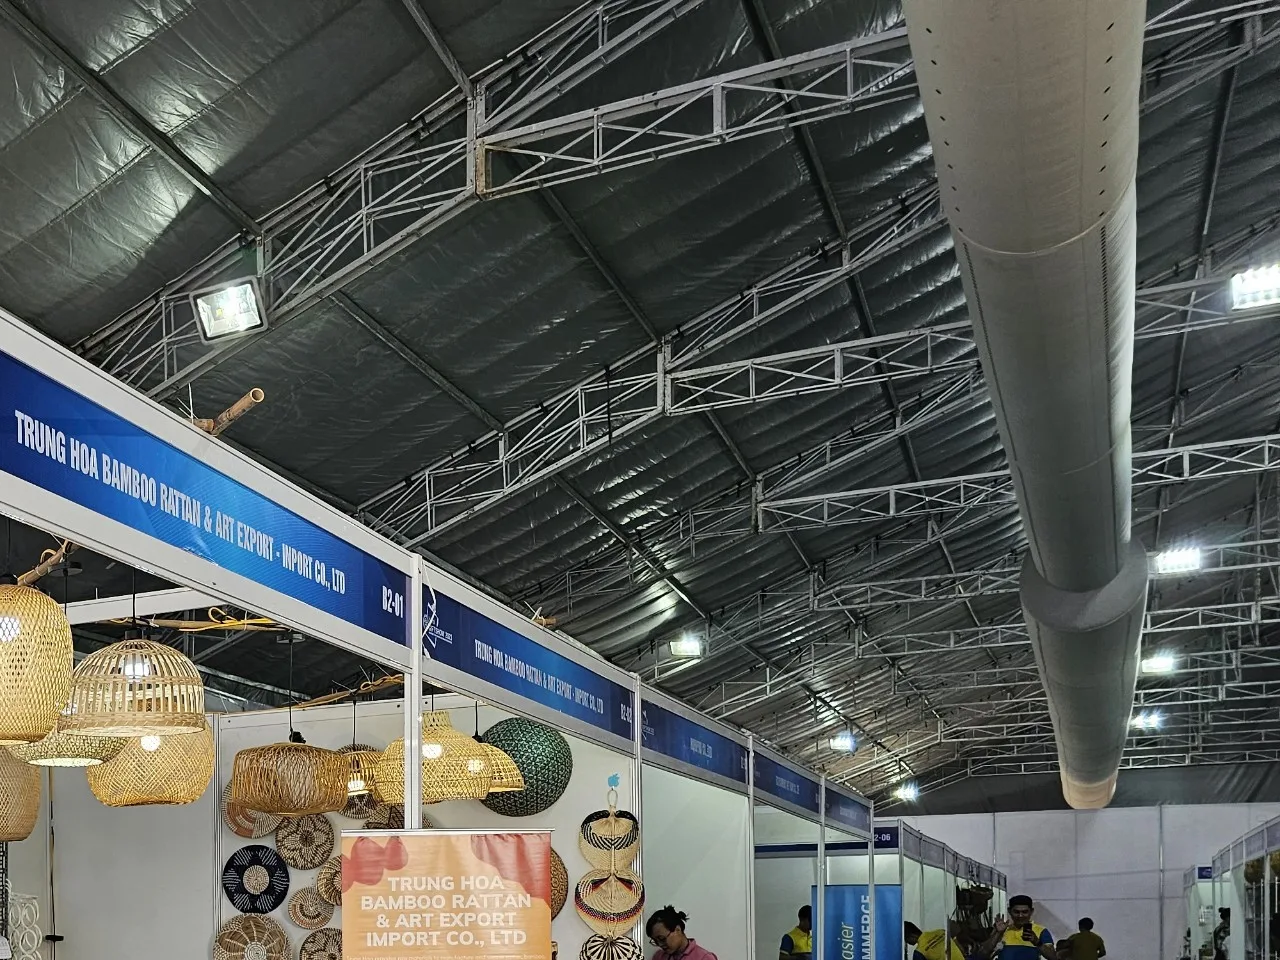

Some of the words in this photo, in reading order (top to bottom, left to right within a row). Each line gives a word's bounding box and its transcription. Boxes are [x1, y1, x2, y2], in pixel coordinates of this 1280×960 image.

[14, 409, 66, 465] TRUNG
[70, 437, 99, 480] HOA
[102, 453, 157, 507] BAMBOO
[160, 482, 201, 528] RATTAN
[203, 505, 213, 534] &
[215, 511, 235, 544] ART
[237, 520, 274, 562] EXPORT
[282, 543, 313, 580] INPORT
[314, 559, 331, 591] CO.,
[331, 567, 346, 595] LTD
[382, 585, 404, 619] B2-01
[474, 638, 492, 664] TRUNG
[493, 648, 505, 670] HOA
[505, 653, 526, 680] BAMBOO
[547, 674, 556, 694] ART
[556, 678, 572, 701] EXPORT
[874, 833, 891, 842] 2-06
[387, 877, 455, 892] TRUNG
[461, 875, 505, 890] HOA
[361, 895, 445, 910] BAMBOO
[452, 894, 531, 909] RATTAN
[376, 914, 390, 928] &
[394, 913, 434, 928] ART
[439, 912, 517, 927] EXPORT
[366, 931, 440, 947] IMPORT
[446, 930, 484, 948] CO.,
[490, 930, 527, 945] LTD
